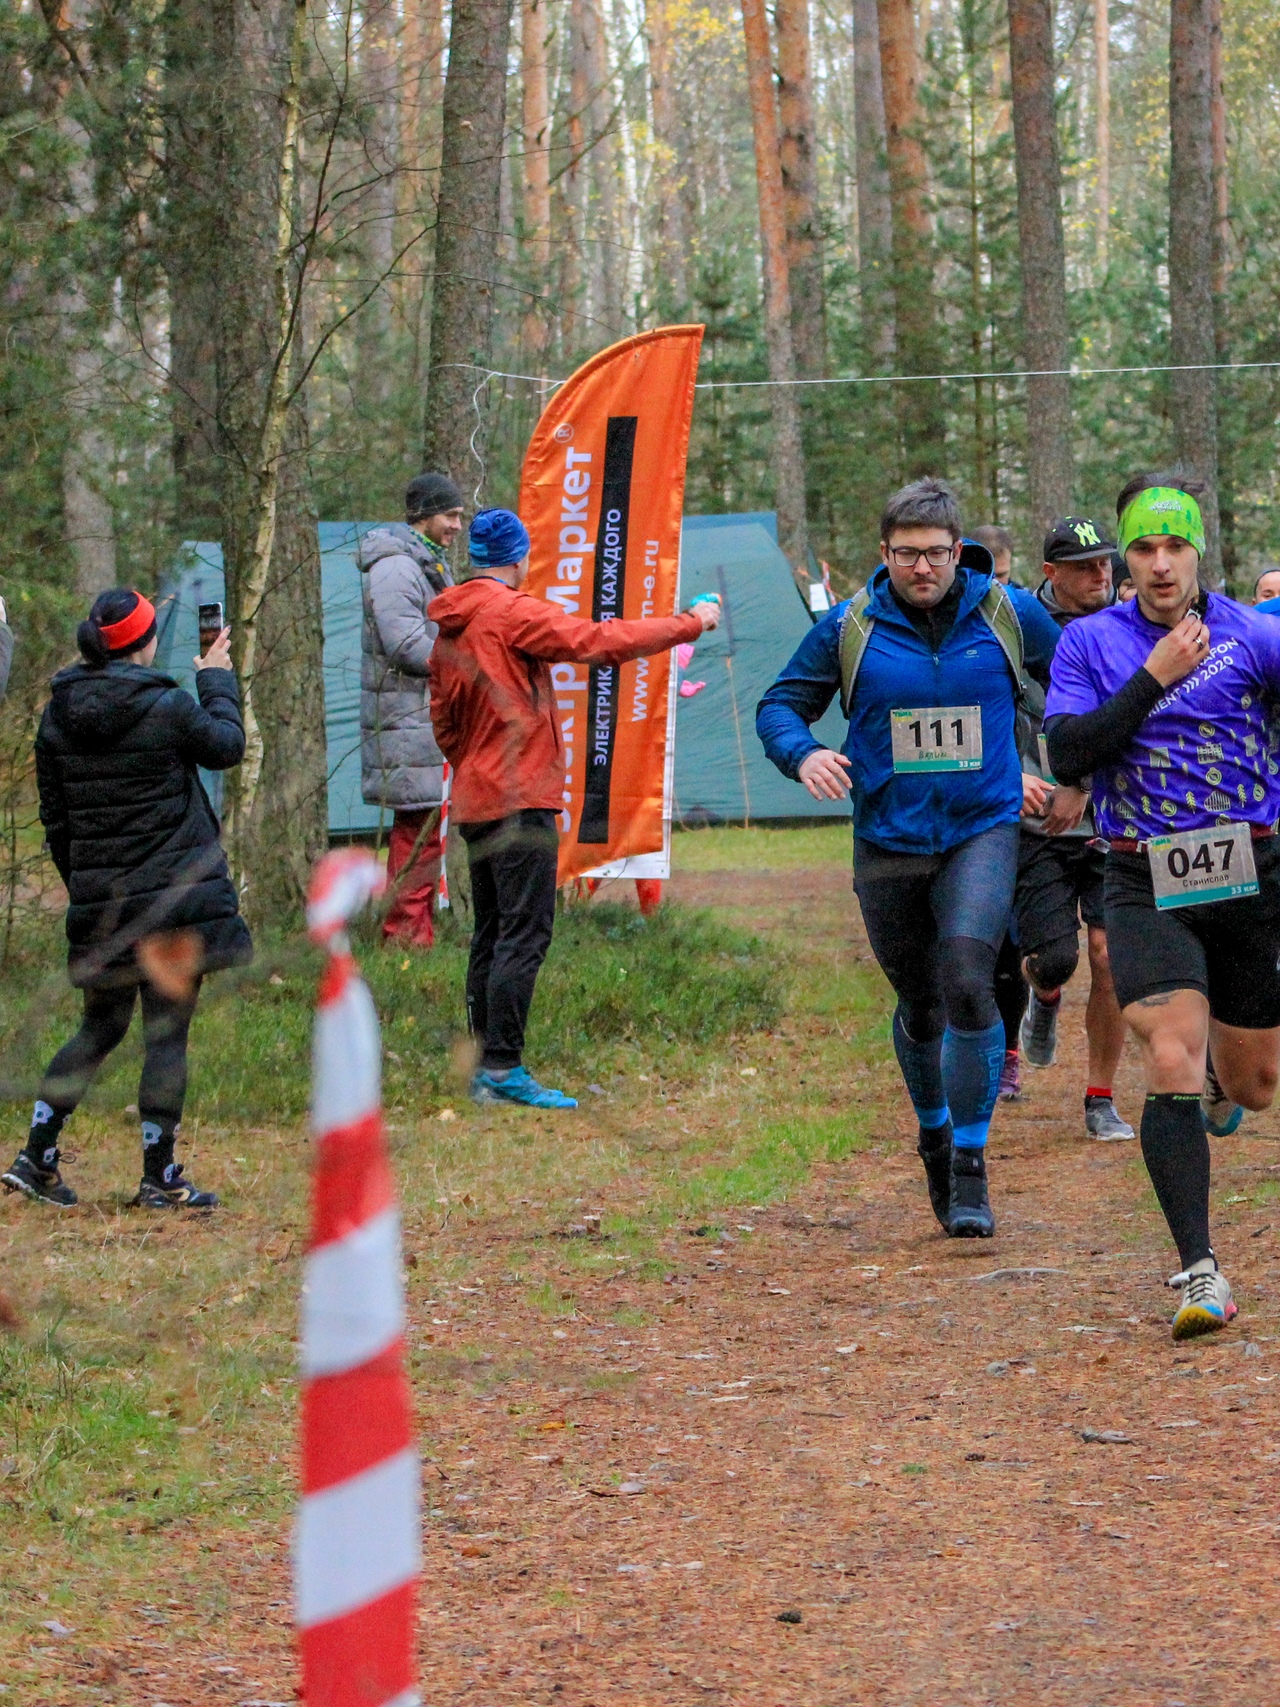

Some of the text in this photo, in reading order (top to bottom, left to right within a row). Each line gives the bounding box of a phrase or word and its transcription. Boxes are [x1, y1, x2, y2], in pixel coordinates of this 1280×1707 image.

[601, 509, 621, 605] КАЖДОГО
[1200, 656, 1234, 681] 2020
[594, 665, 613, 765] ЭЛЕКТРИК
[908, 719, 964, 748] 111
[958, 760, 969, 768] 33
[1167, 838, 1235, 879] 047
[1182, 873, 1230, 888] Станислав
[1231, 886, 1242, 895] 33
